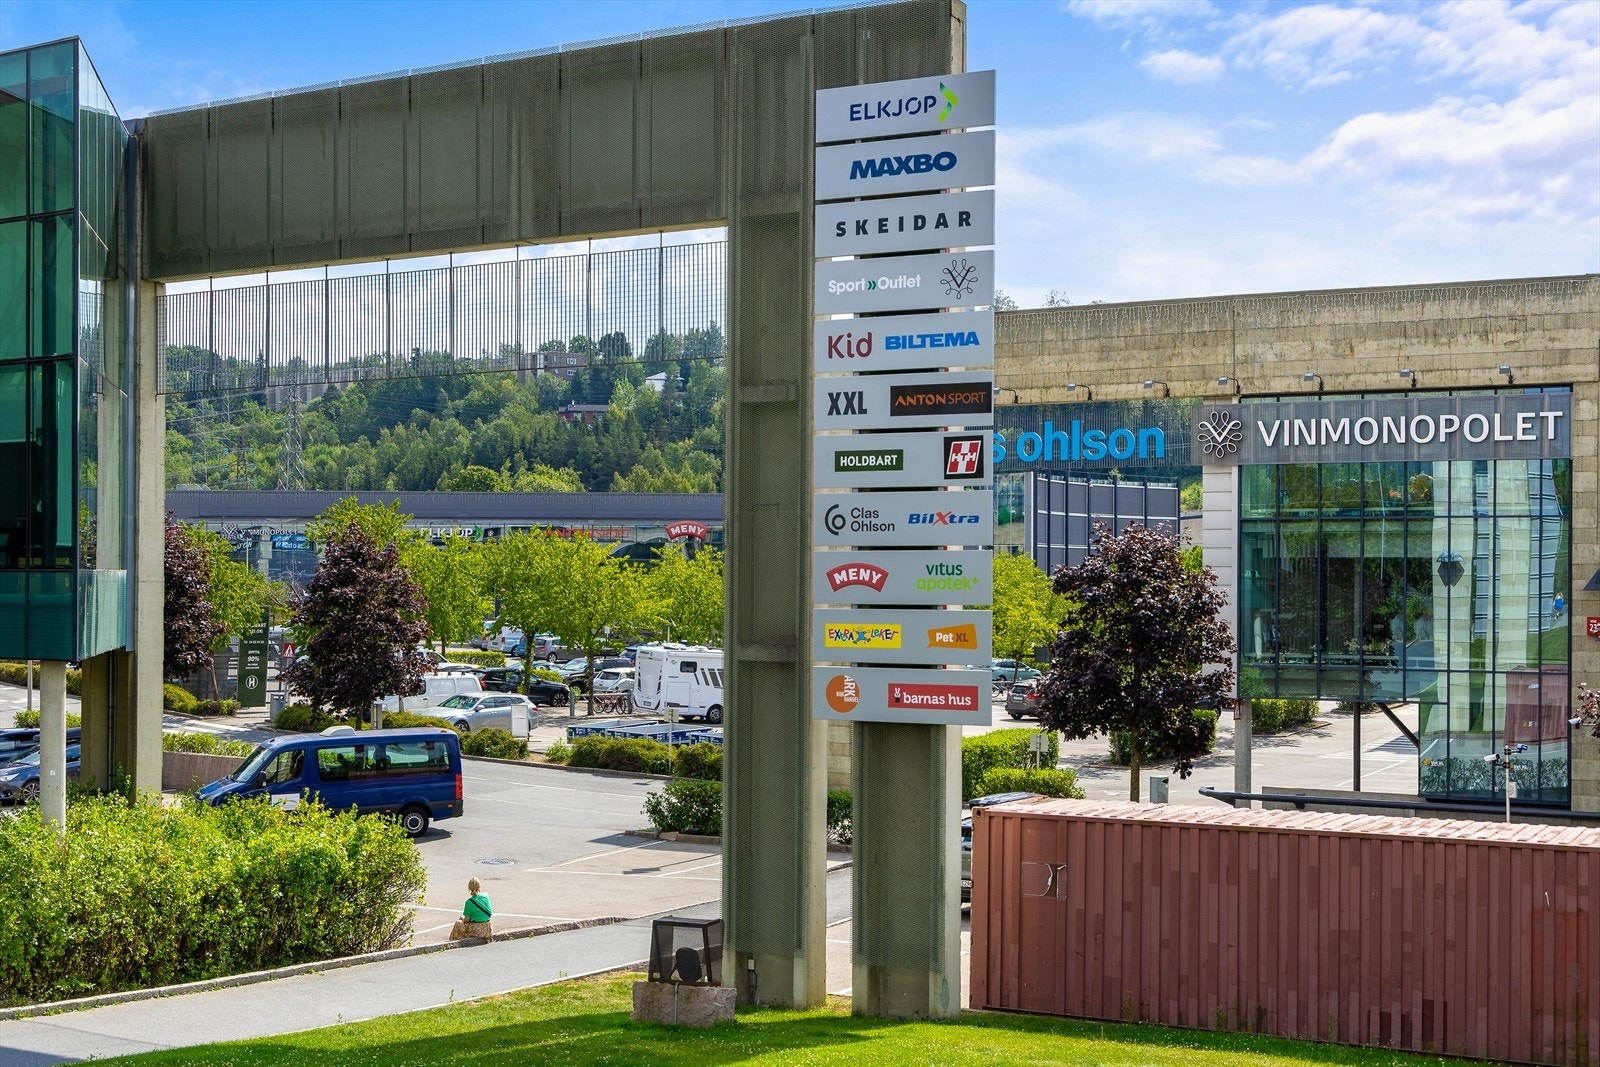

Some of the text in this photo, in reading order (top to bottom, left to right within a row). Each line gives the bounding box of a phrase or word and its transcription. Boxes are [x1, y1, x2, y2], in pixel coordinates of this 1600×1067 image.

[849, 151, 958, 180] MAXBO
[835, 210, 972, 238] SKEIDAR
[827, 331, 873, 359] Kid
[884, 331, 980, 350] BILTEMA
[827, 390, 868, 416] XXL
[894, 391, 987, 407] ANTON SPORT
[1256, 410, 1564, 447] VINMONOPOLET
[1016, 419, 1165, 462] ohlson
[840, 454, 898, 467] HOLDBART
[850, 507, 880, 519] Clas
[907, 510, 980, 527] BilXtra
[670, 524, 705, 536] MENY
[850, 520, 896, 532] Ohlson
[833, 568, 882, 585] MENY
[925, 562, 963, 576] vitus
[935, 632, 969, 643] Pet XL
[843, 674, 857, 696] ARK
[902, 691, 972, 706] barnas hus
